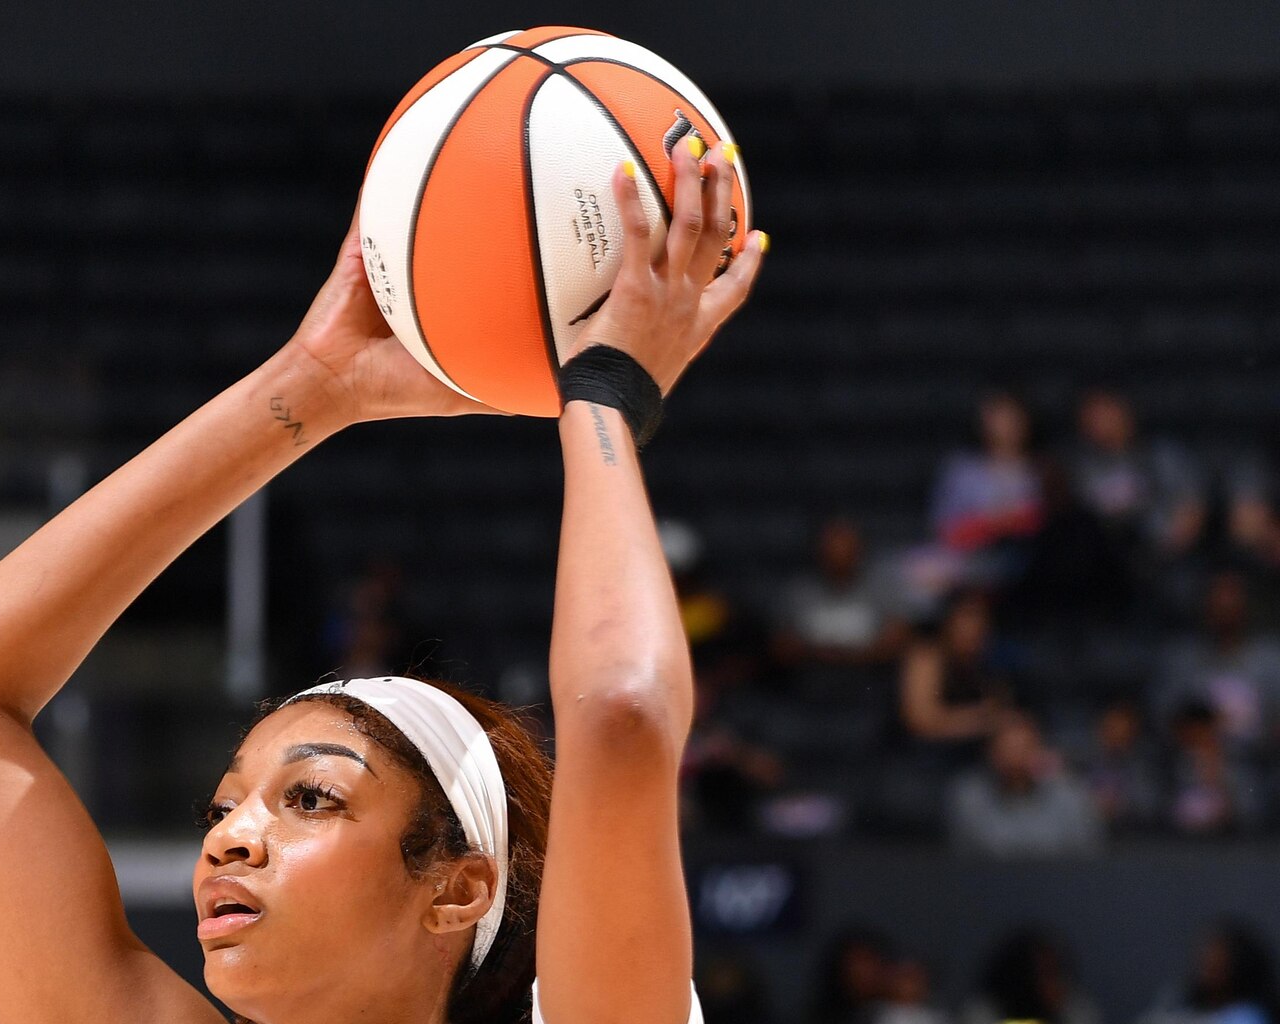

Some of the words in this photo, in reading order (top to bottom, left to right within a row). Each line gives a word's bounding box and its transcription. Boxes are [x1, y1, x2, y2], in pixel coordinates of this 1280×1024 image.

[574, 188, 592, 230] GAME
[588, 232, 600, 270] BALL
[588, 194, 610, 256] OFFICIAL
